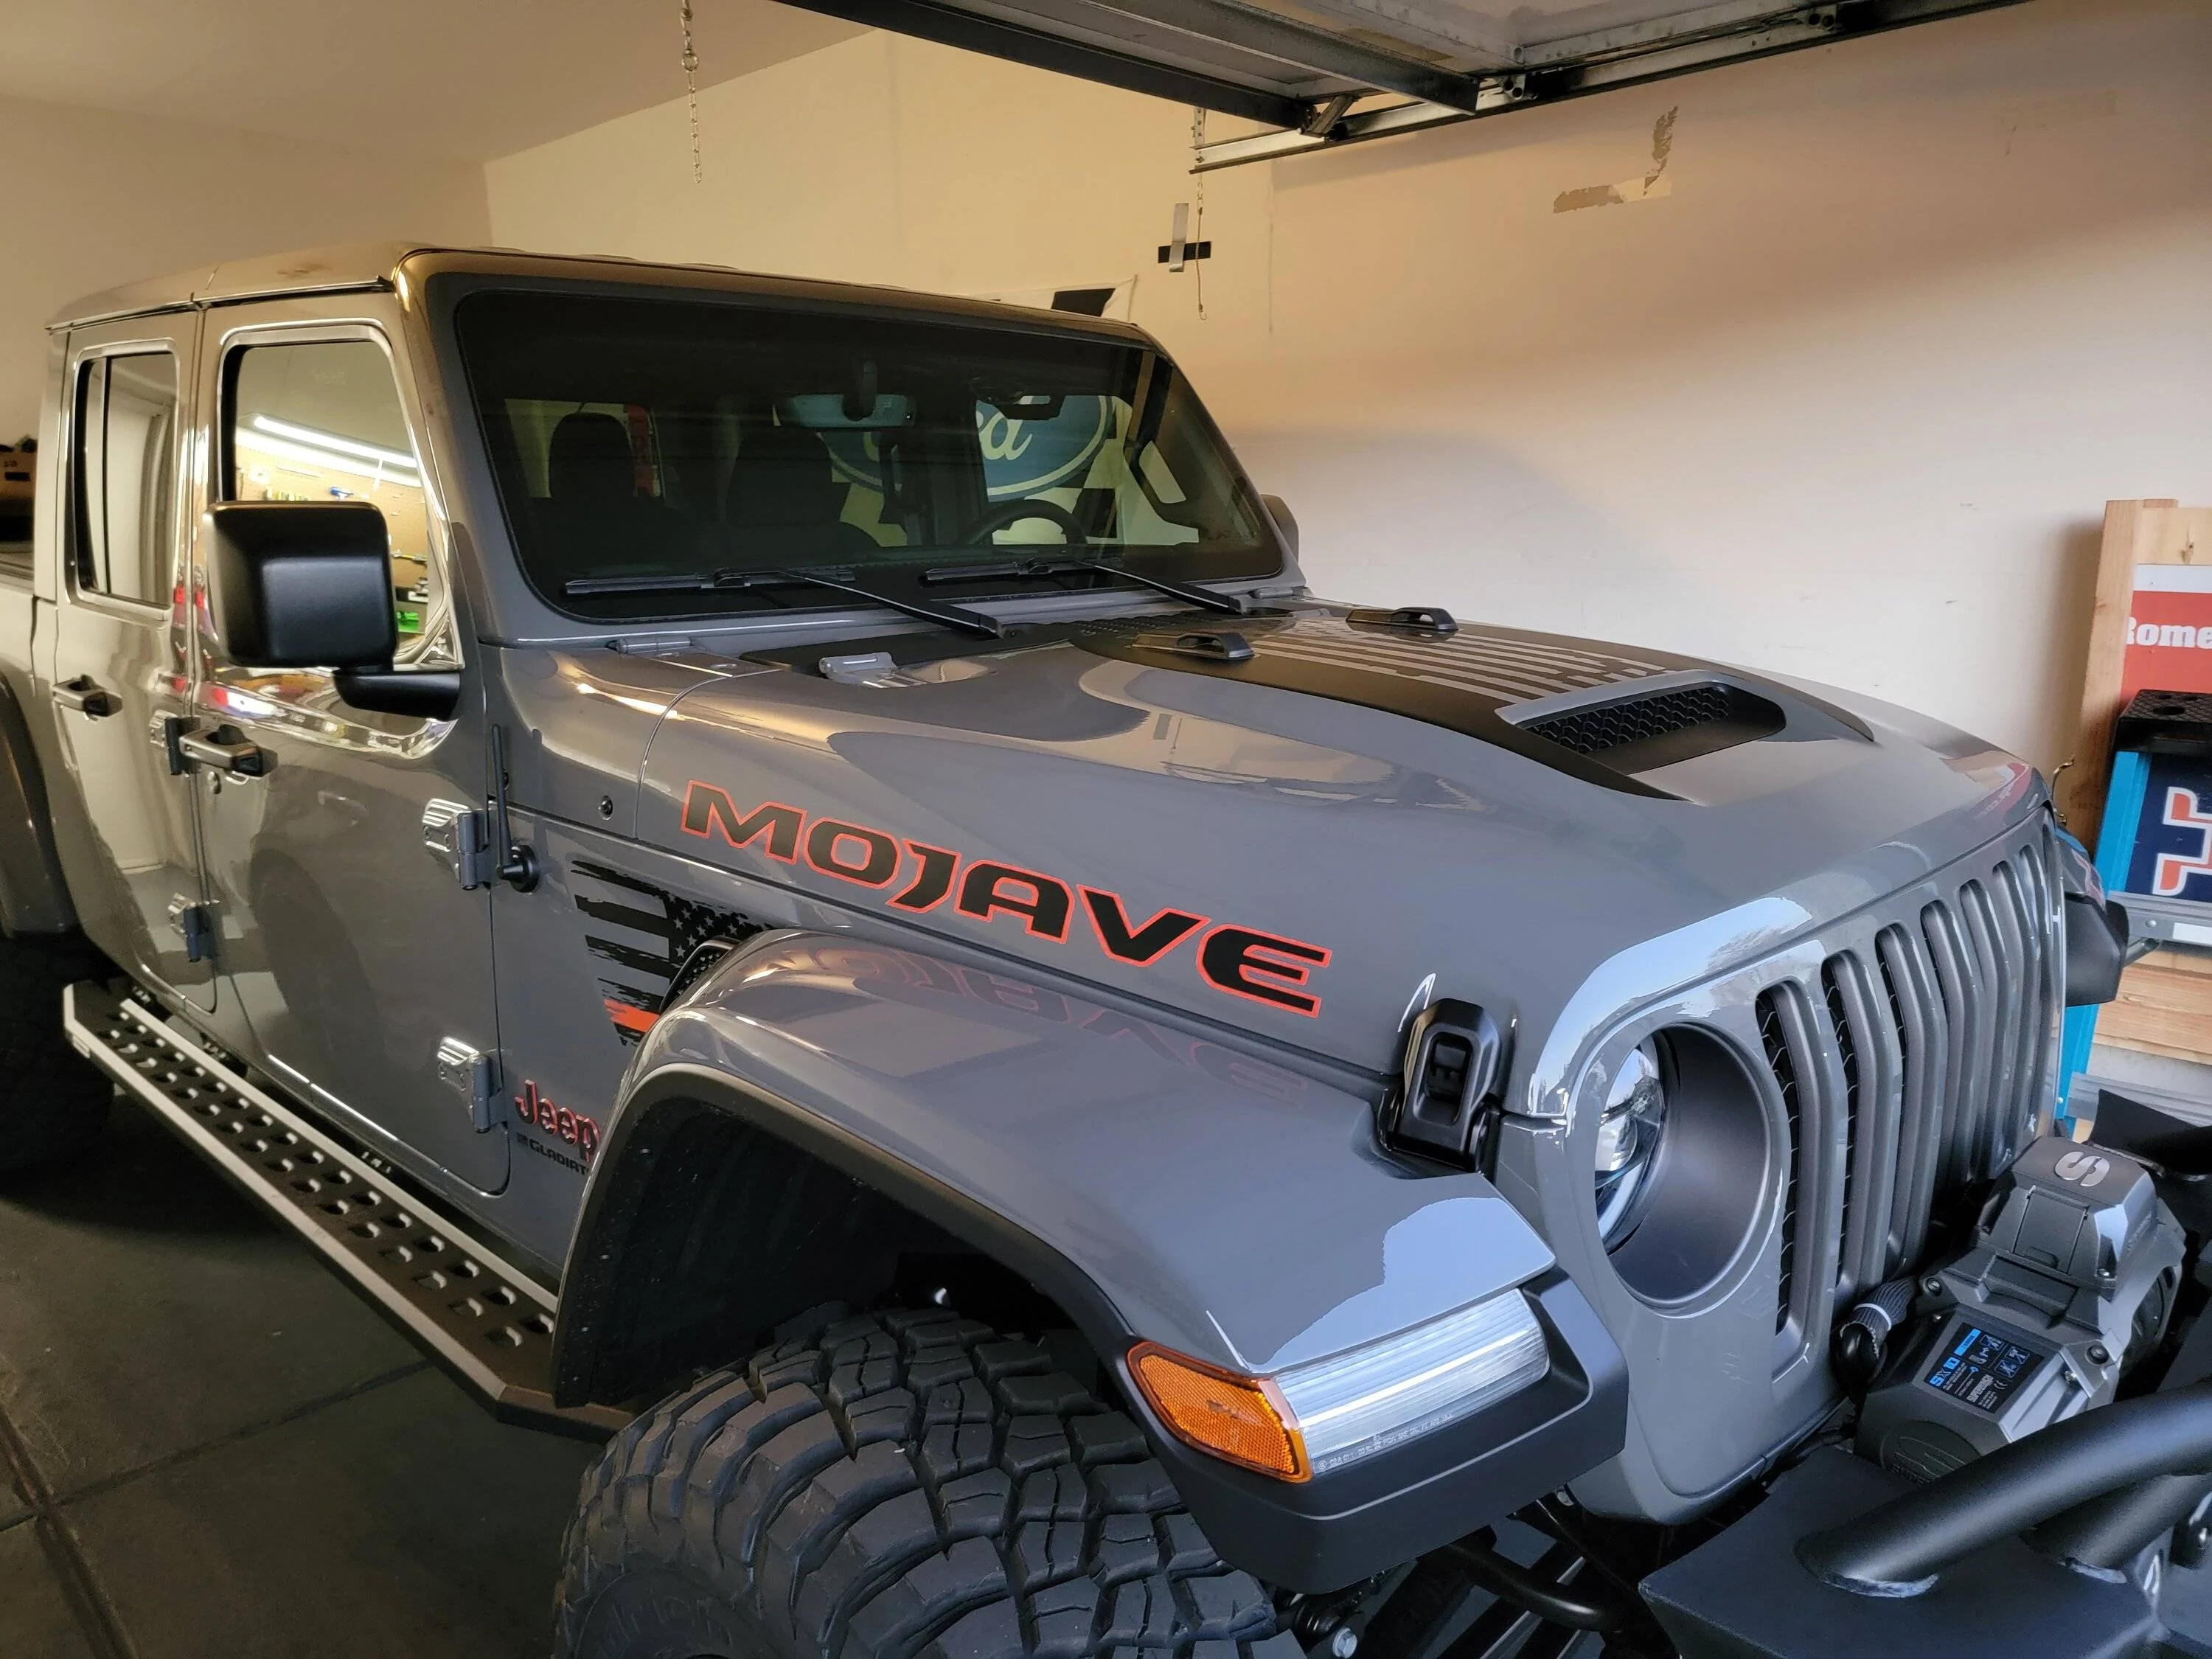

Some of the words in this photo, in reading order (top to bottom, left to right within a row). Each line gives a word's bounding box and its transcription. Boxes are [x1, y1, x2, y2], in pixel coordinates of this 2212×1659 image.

[681, 779, 1332, 1018] MOJAVE
[515, 1079, 600, 1163] Jeep
[529, 1138, 590, 1175] GLADIAT
